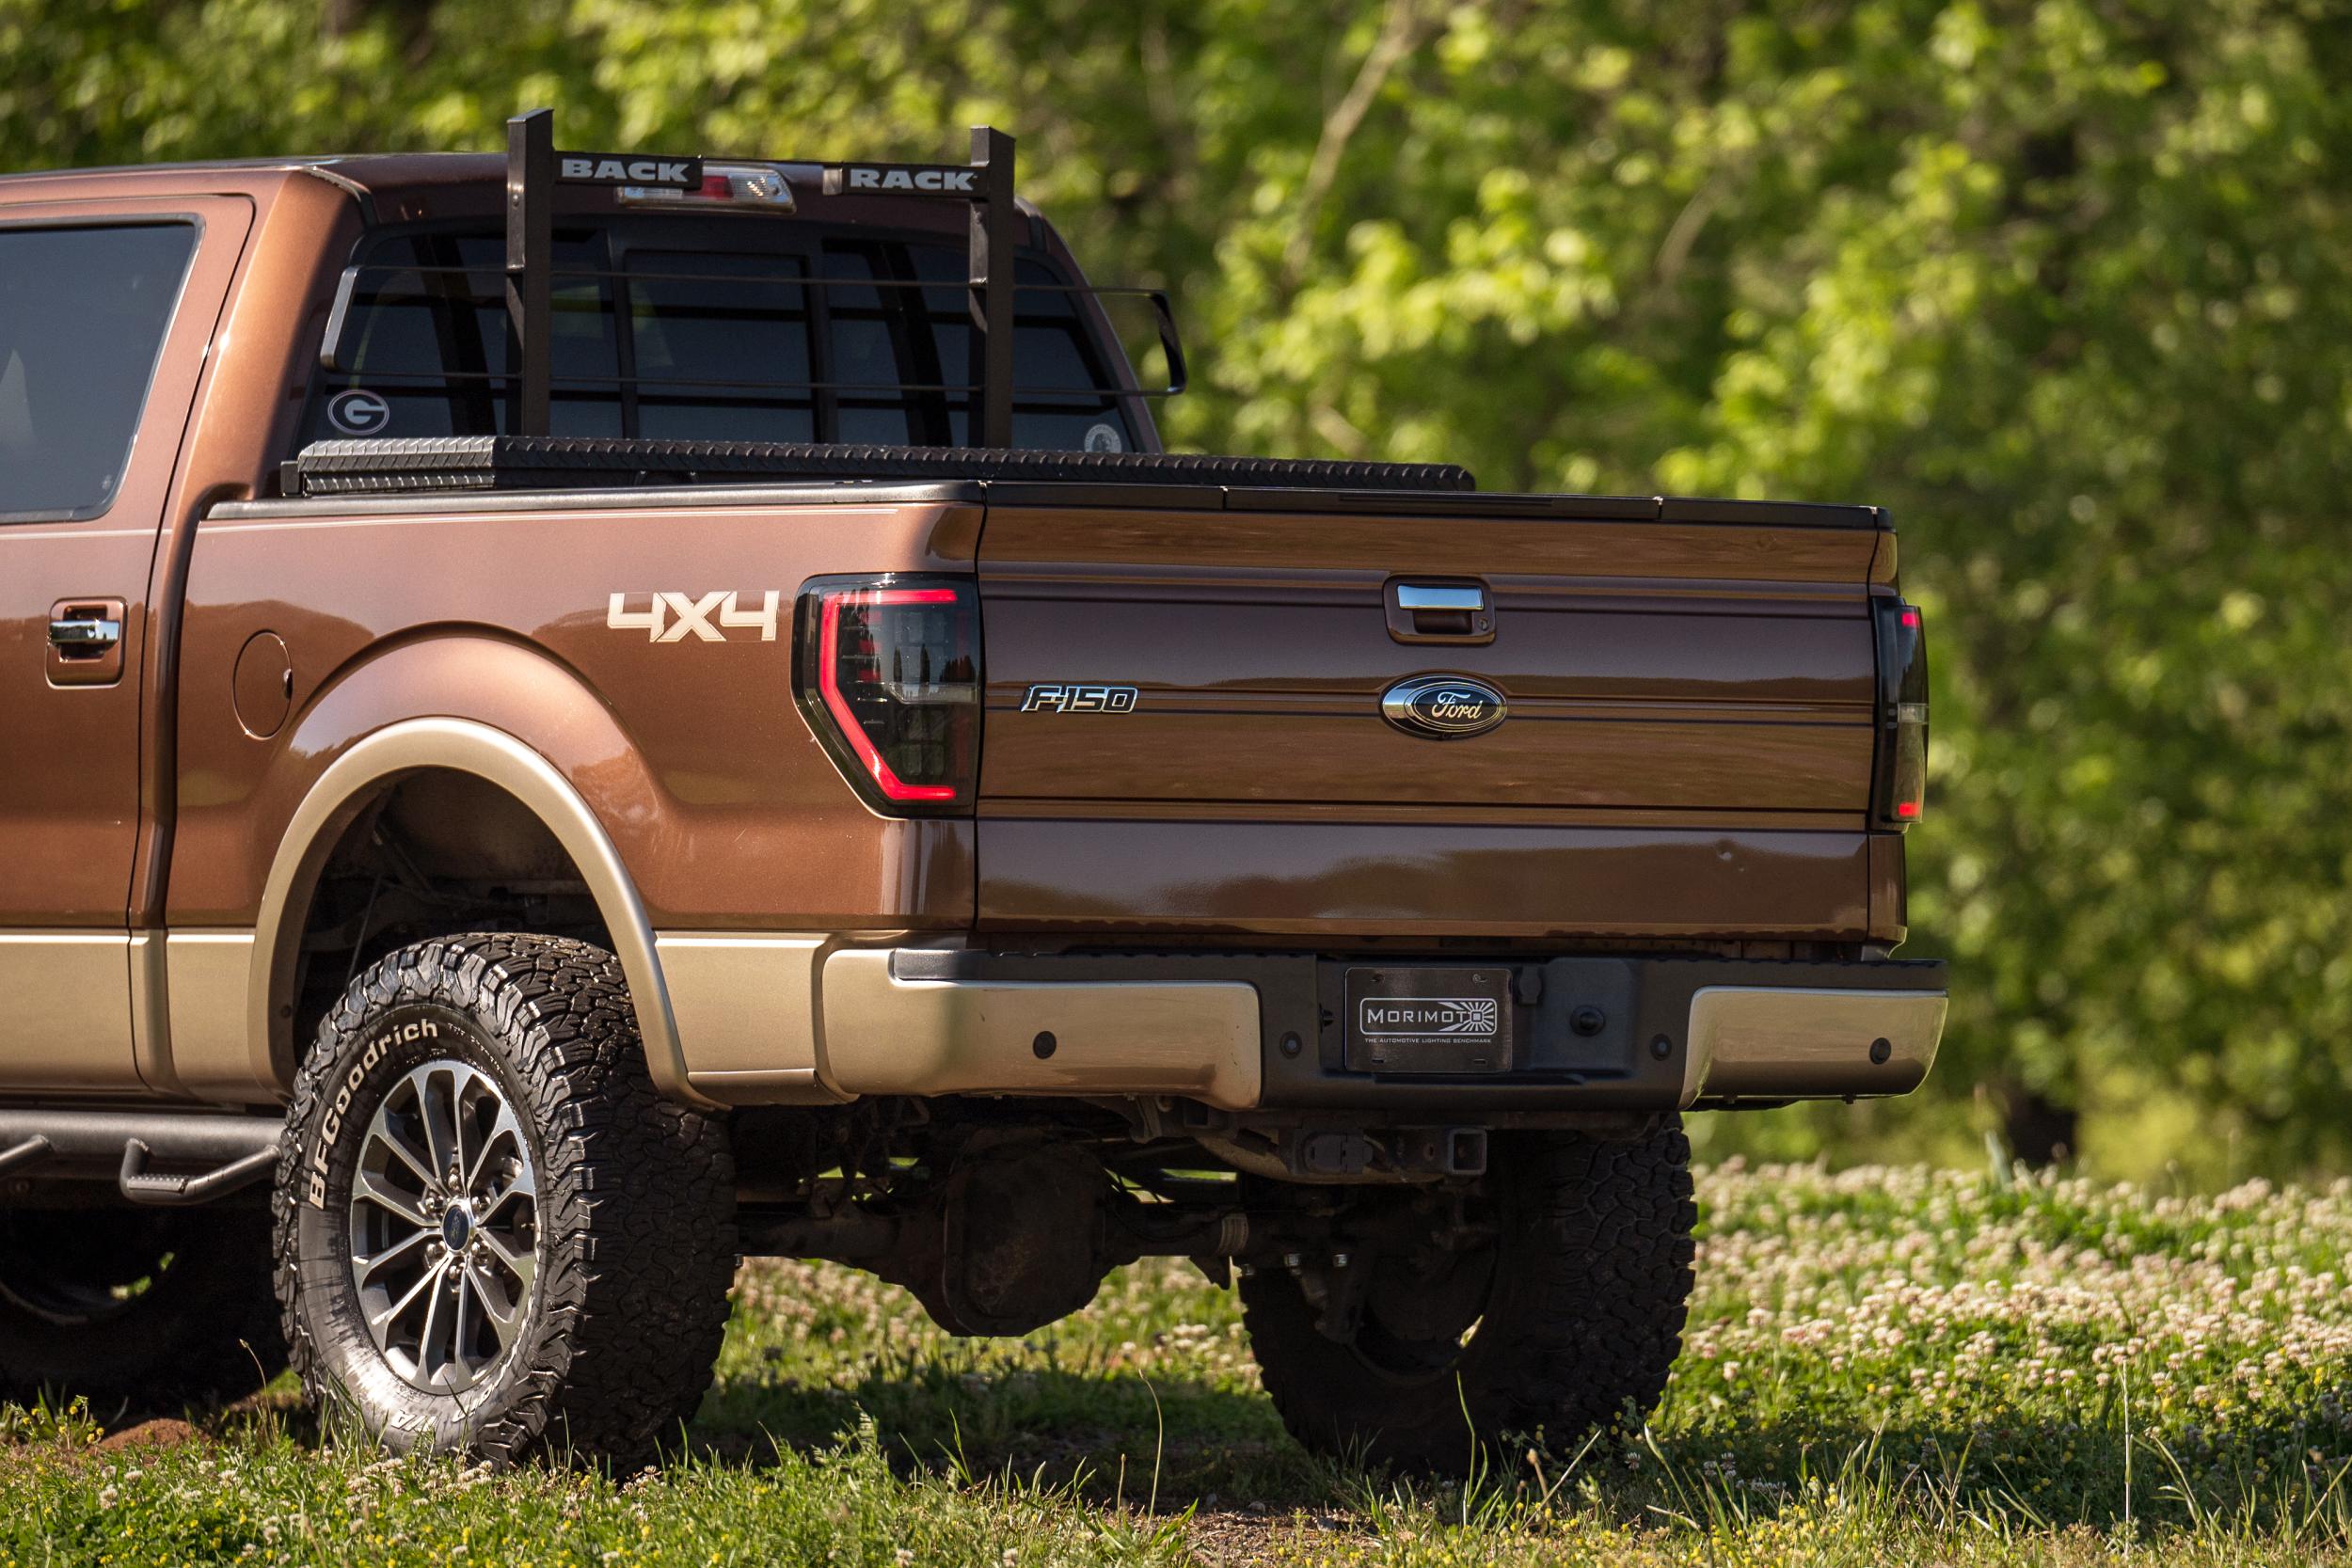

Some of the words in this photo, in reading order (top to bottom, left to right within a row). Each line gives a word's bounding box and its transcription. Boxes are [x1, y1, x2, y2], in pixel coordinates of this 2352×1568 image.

[562, 158, 690, 182] BACK
[850, 168, 975, 191] RACK
[344, 399, 386, 425] G
[607, 591, 780, 643] 4X4
[1021, 685, 1138, 713] F-150
[1431, 691, 1484, 720] Ford
[309, 1018, 438, 1211] BFGoodrich
